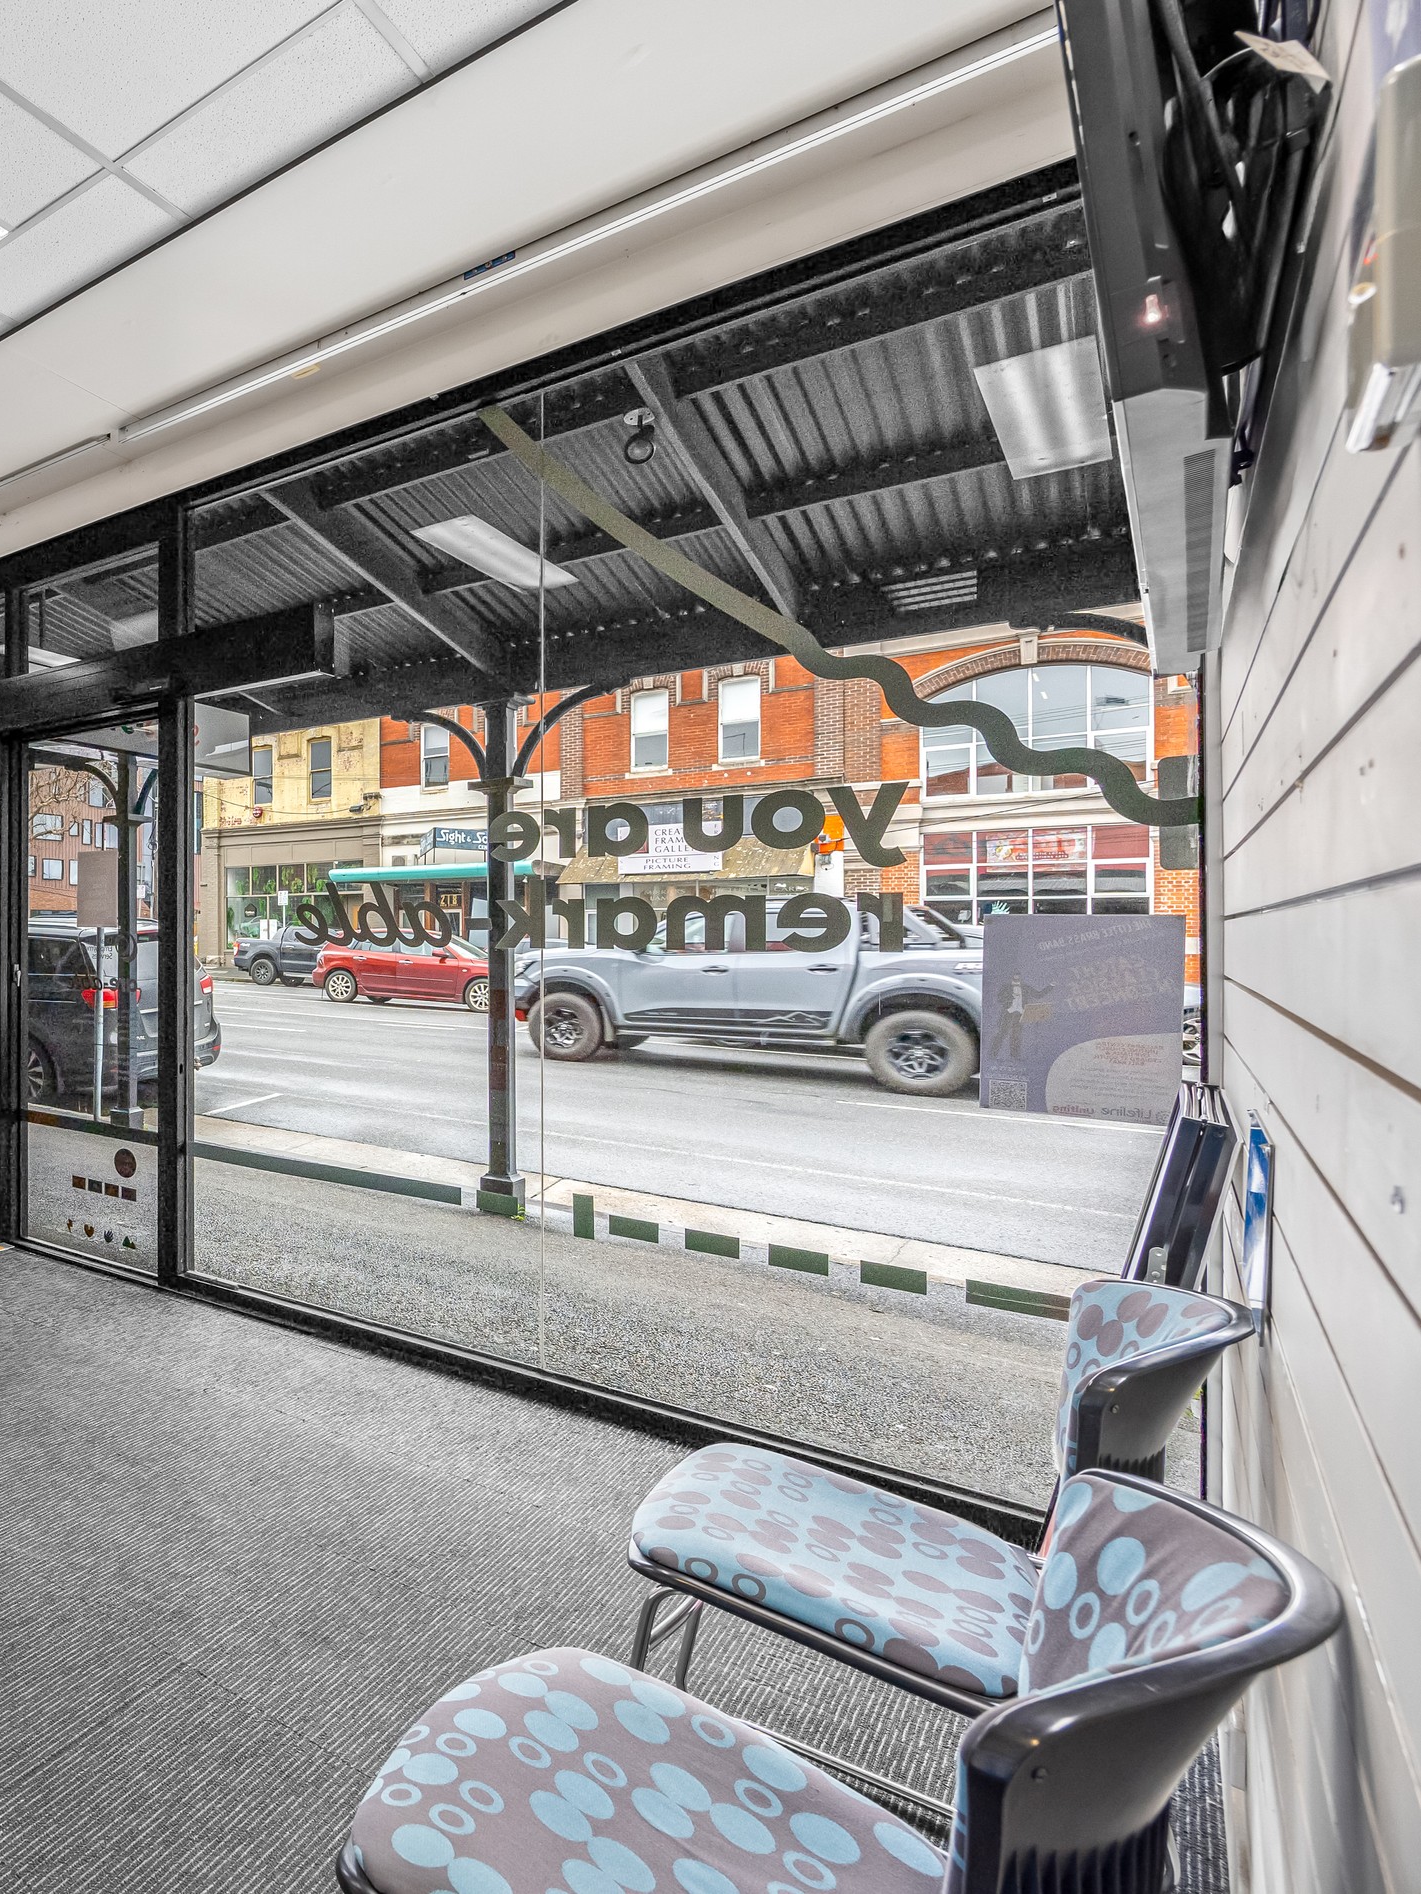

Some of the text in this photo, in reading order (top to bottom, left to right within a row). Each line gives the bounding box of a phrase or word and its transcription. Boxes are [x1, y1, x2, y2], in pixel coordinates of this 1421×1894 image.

[436, 829, 466, 845] Sight
[654, 844, 694, 853] GALLE
[643, 863, 691, 871] FRAMING
